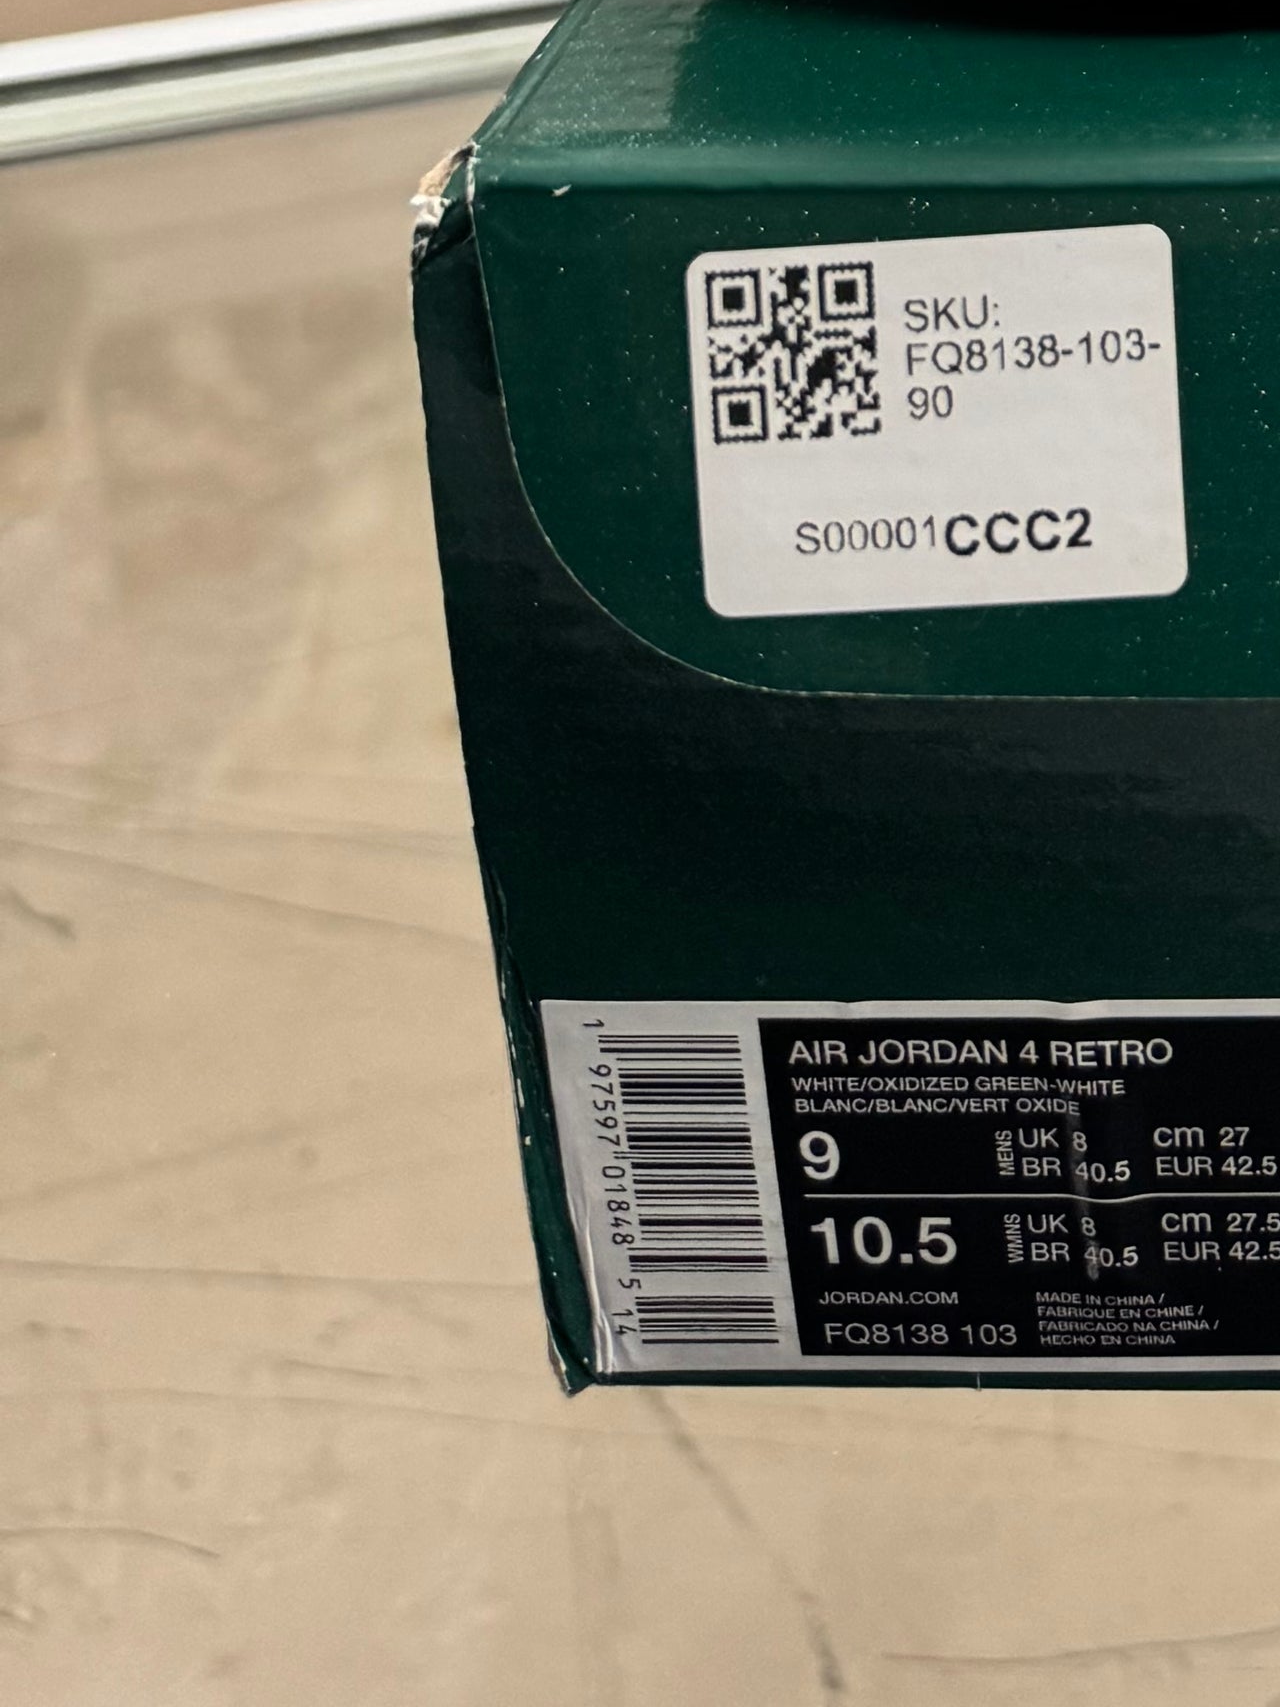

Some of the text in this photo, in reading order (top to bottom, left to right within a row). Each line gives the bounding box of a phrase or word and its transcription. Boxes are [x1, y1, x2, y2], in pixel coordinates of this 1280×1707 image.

[903, 295, 1000, 332] SKU:
[905, 328, 1161, 376] FQ8138-103-
[906, 385, 954, 421] 90
[795, 508, 1094, 556] S00001CCC2
[788, 1038, 1173, 1067] AIR JORDAN 4 RETRO
[791, 1077, 1125, 1096] WHITE/OXIDIZED GREEN-WHITE
[795, 1098, 1080, 1115] BLANC/BLANC/VERT OXIDE
[1018, 1128, 1088, 1152] UK 8
[1153, 1127, 1250, 1148] cm 27
[582, 1019, 641, 1290] 1 97597 01848 5
[799, 1130, 840, 1180] 9
[994, 1130, 1016, 1176] MENS
[1022, 1157, 1131, 1183] BR 40.5
[1156, 1156, 1277, 1176] EUR 42.5
[1027, 1214, 1096, 1236] UK 8
[1161, 1212, 1212, 1233] cm
[810, 1216, 958, 1266] 10.5
[1004, 1213, 1023, 1263] WMNS
[1031, 1242, 1138, 1268] BR 40.5
[1164, 1242, 1221, 1262] EUR
[819, 1291, 959, 1306] JORDAN.COM
[1036, 1291, 1081, 1304] MADE
[1086, 1294, 1101, 1305] IN
[1104, 1294, 1155, 1306] CHINA
[612, 1308, 637, 1336] 14
[1037, 1306, 1115, 1319] FABRIQUE
[1119, 1308, 1140, 1319] EN
[1145, 1305, 1194, 1318] CHINE
[824, 1323, 1017, 1347] FQ8138 103
[1038, 1320, 1128, 1332] FABRICADO
[1133, 1321, 1157, 1332] NA
[1160, 1319, 1210, 1331] CHINA
[1040, 1334, 1176, 1345] HECHO EN CHINA
